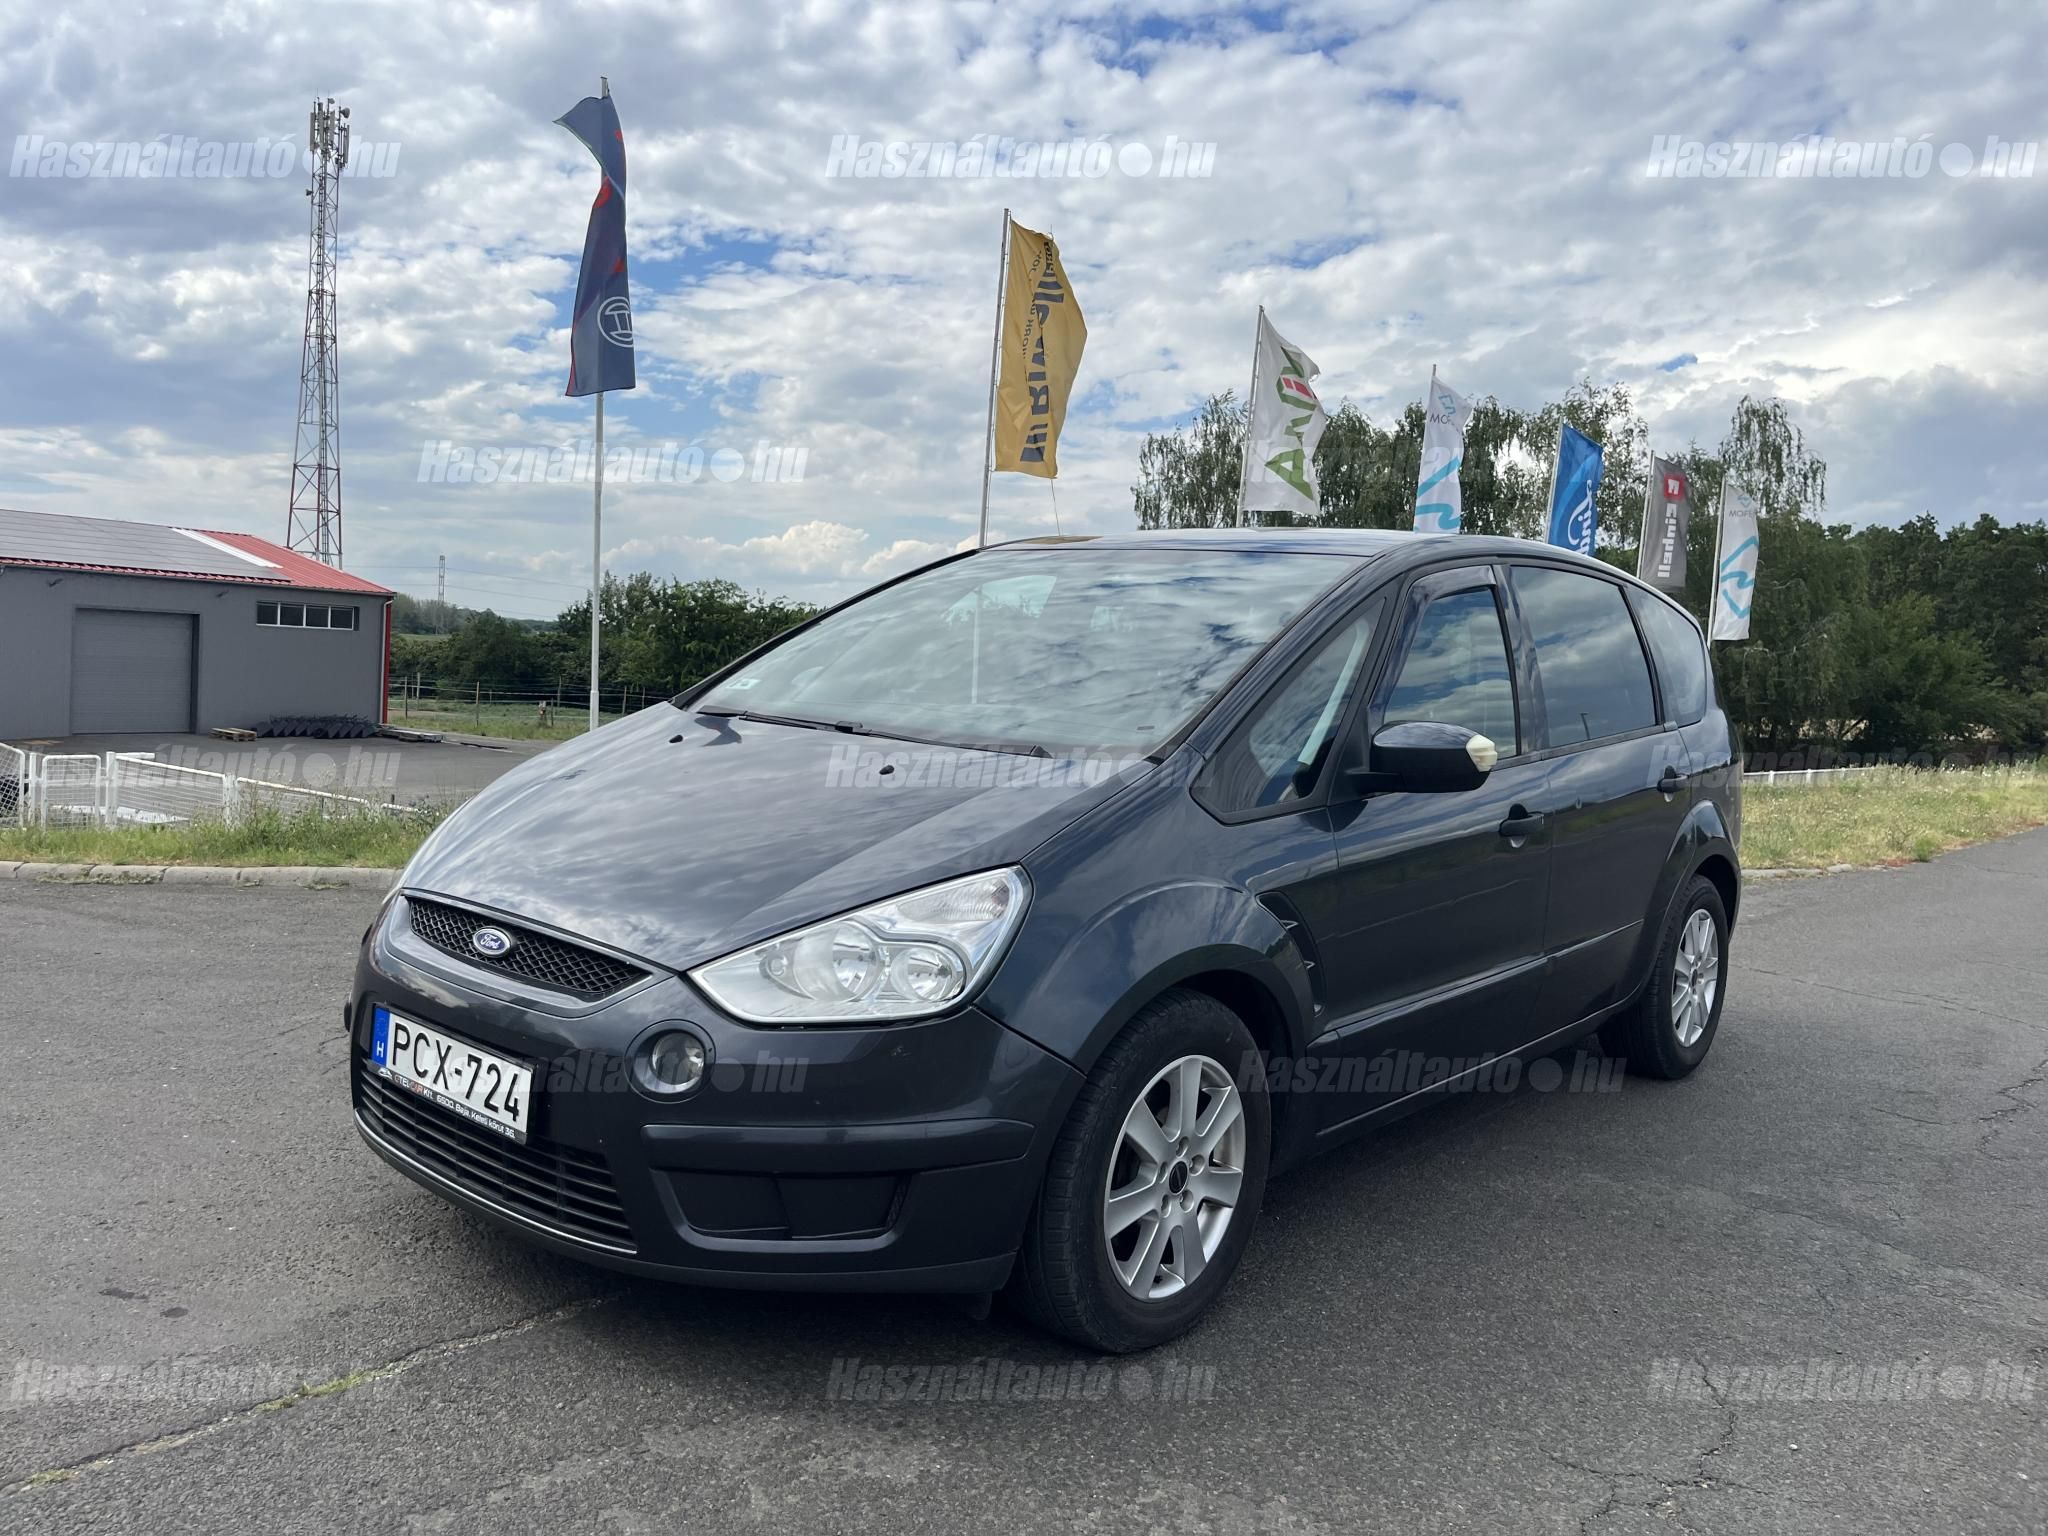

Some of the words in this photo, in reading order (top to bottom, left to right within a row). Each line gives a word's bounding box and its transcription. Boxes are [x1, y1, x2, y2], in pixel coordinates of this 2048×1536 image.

[480, 933, 502, 949] Ford
[376, 1040, 385, 1058] H
[392, 1022, 520, 1122] PCX-724
